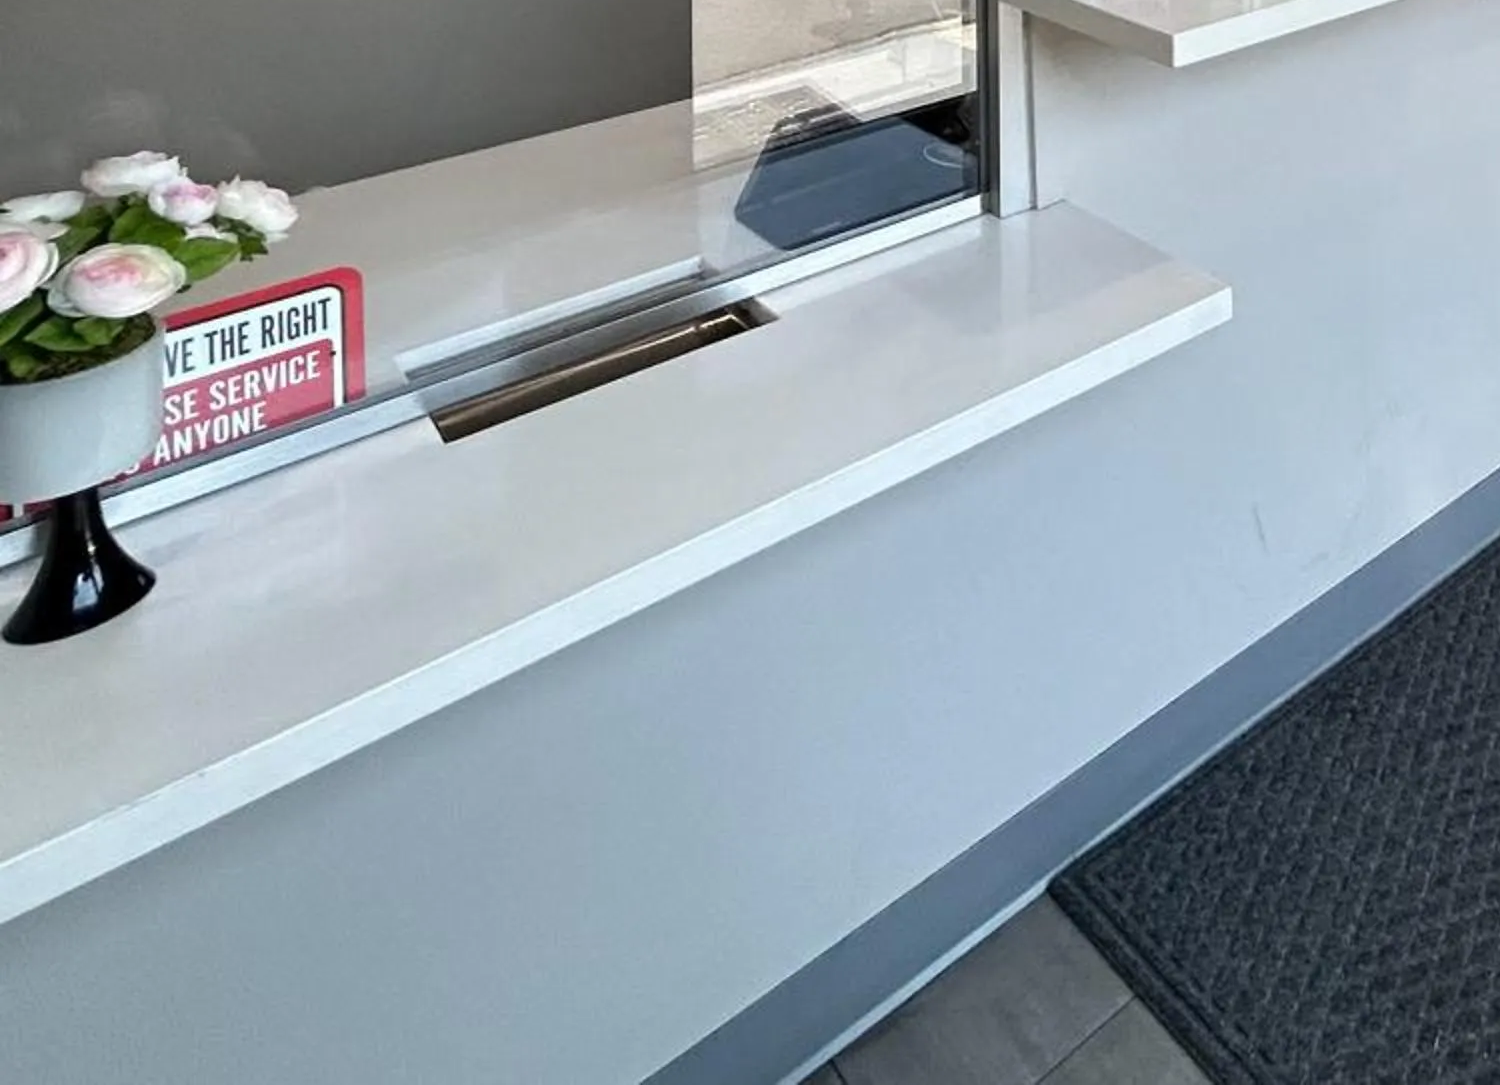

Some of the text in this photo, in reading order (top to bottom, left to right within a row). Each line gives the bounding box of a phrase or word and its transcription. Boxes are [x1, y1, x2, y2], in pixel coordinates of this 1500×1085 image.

[204, 322, 250, 366] THE
[261, 297, 332, 350] RIGHT
[209, 350, 321, 411] SERVICE
[153, 401, 268, 467] ANYONE
